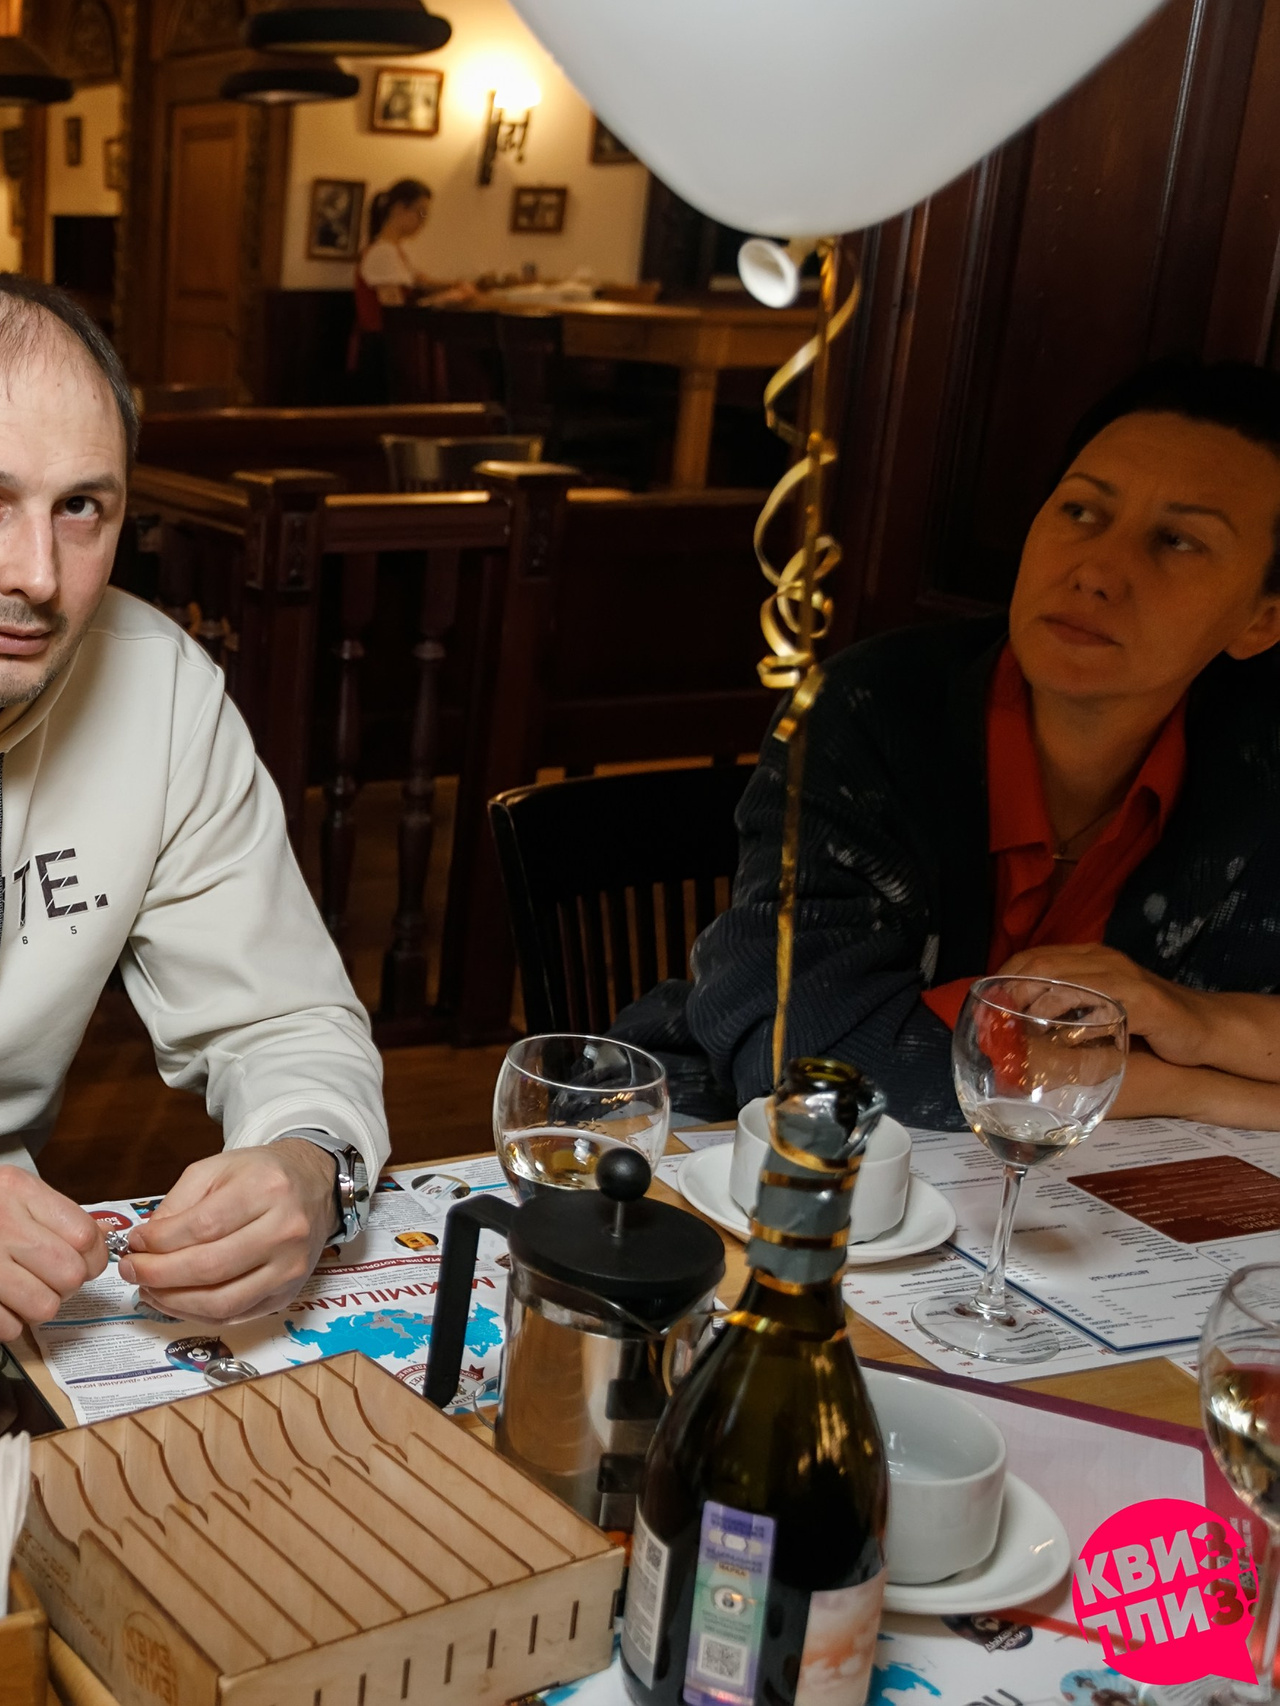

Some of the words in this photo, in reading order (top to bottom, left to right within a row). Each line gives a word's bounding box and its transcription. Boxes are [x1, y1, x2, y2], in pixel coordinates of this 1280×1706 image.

[355, 1259, 397, 1271] КОТОРЫЕ
[286, 1276, 496, 1313] MXIMILIANS
[141, 1372, 173, 1382] ПРОЕКТ
